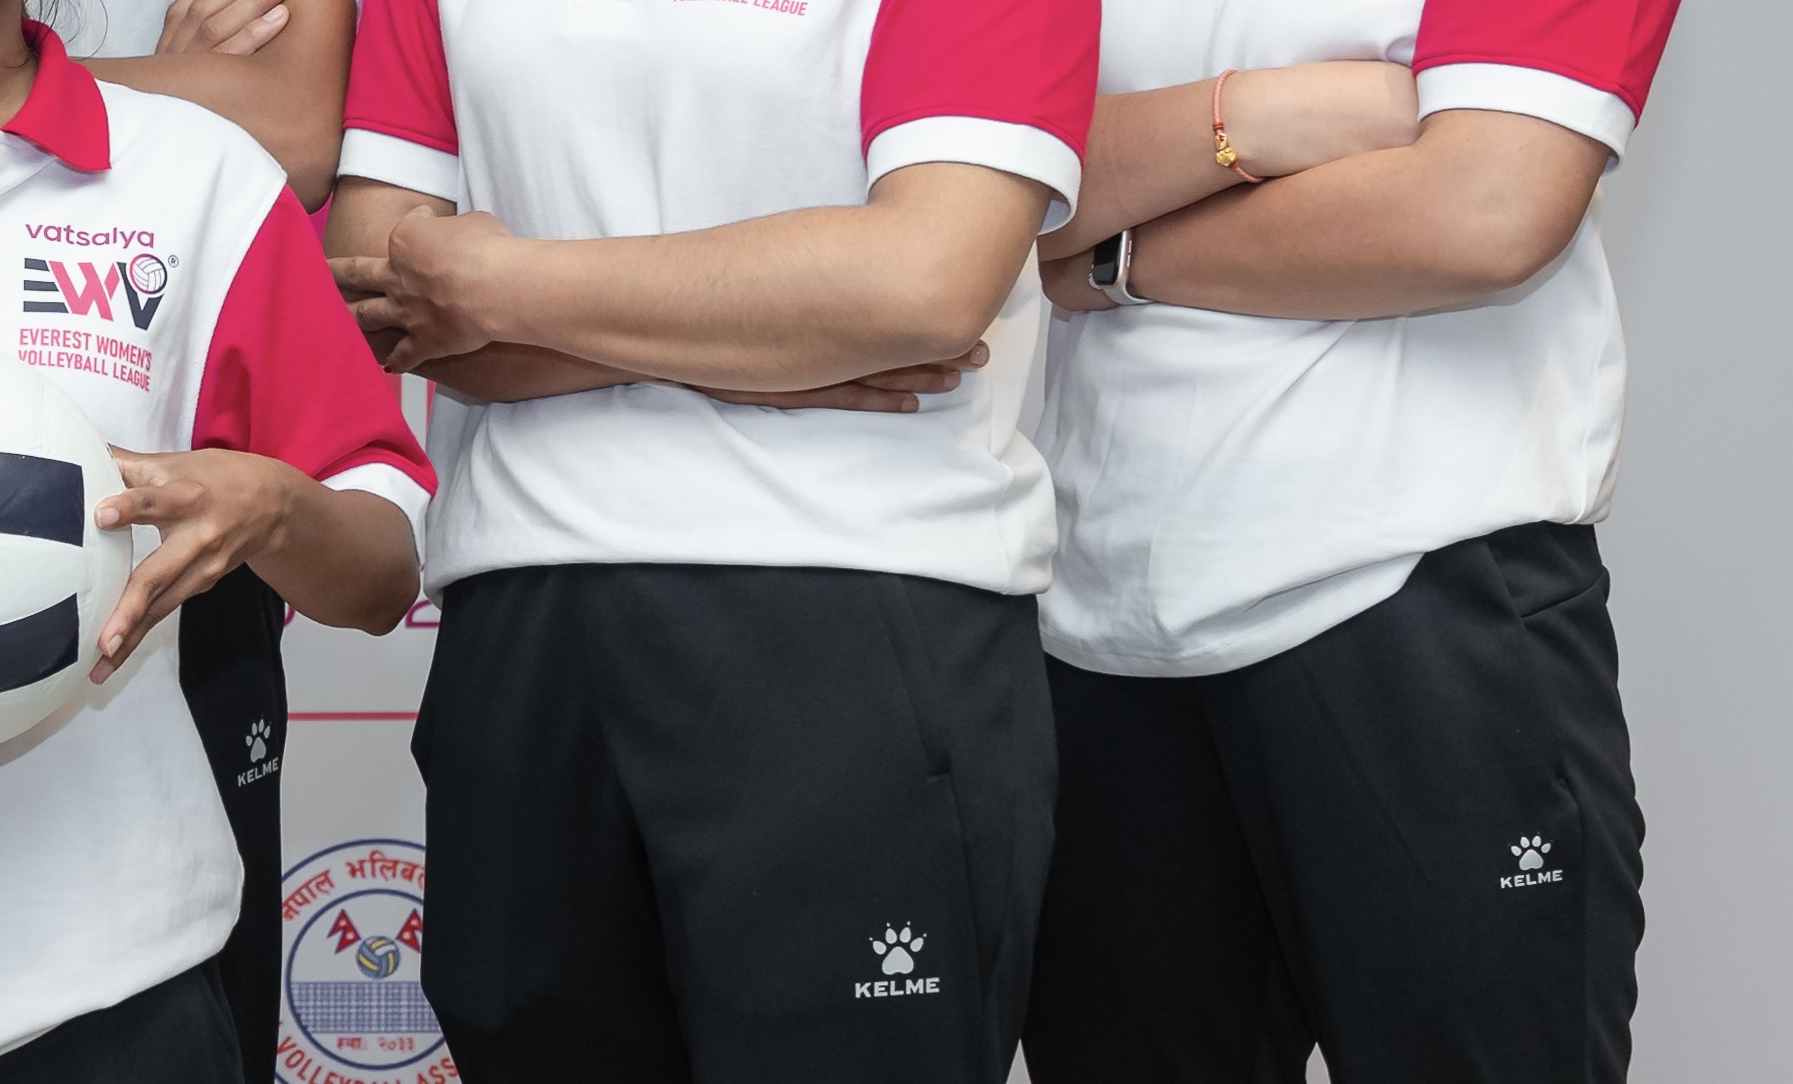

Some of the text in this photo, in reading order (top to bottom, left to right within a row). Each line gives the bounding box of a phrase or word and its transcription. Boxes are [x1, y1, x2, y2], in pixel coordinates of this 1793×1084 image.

[24, 223, 156, 250] vatsalya
[18, 327, 153, 373] EVEREST WOMEN'S
[17, 348, 152, 394] VOLLEYBALL LEAGUE
[237, 756, 279, 788] KELME
[1499, 869, 1564, 889] KELME
[854, 976, 940, 999] KELME
